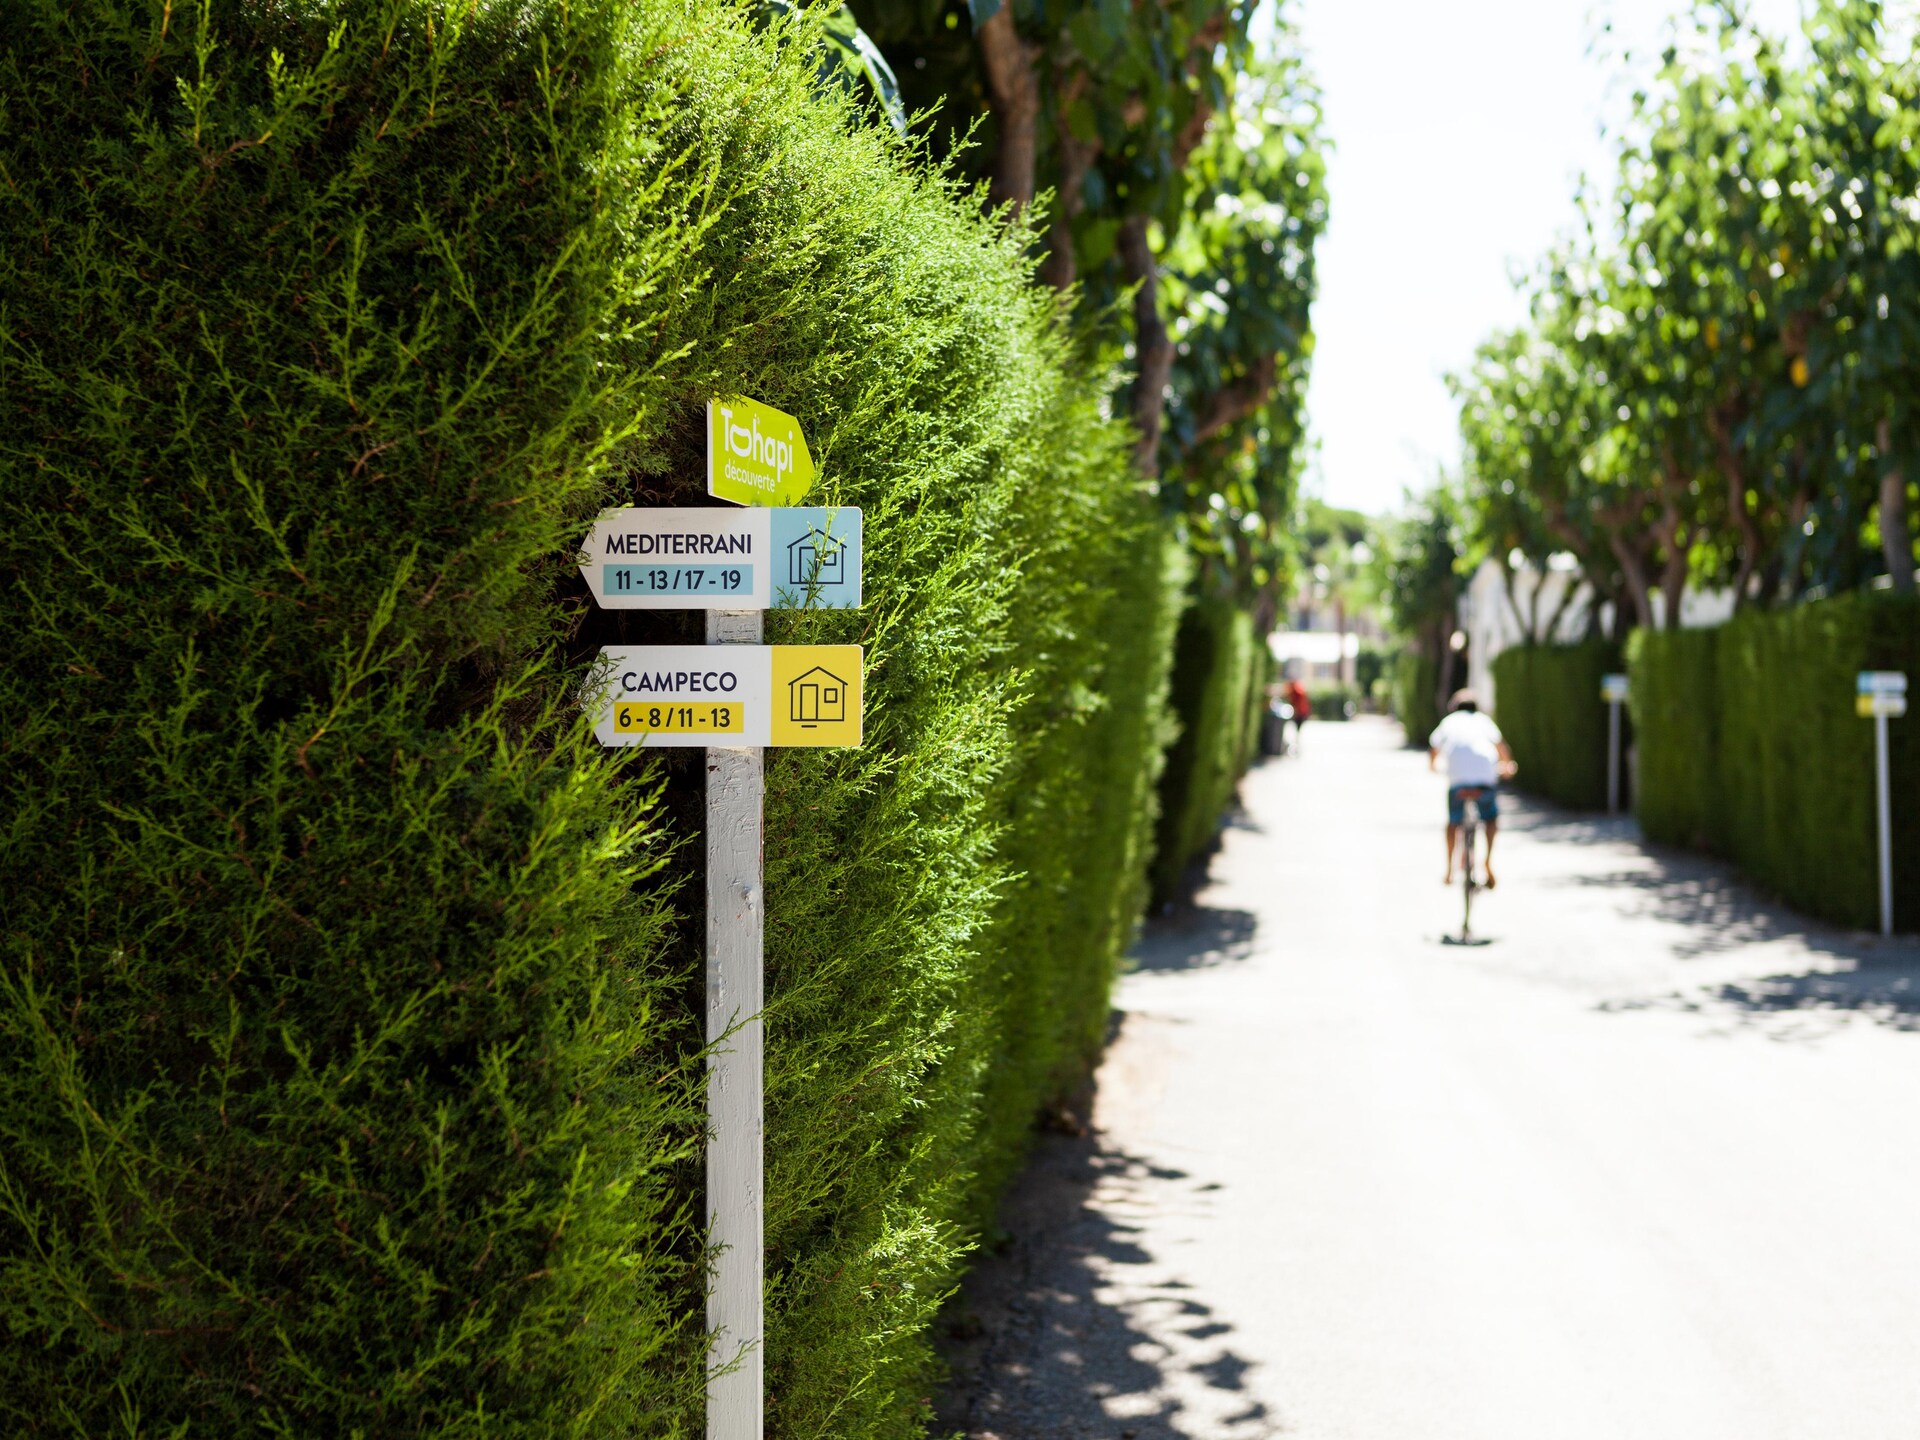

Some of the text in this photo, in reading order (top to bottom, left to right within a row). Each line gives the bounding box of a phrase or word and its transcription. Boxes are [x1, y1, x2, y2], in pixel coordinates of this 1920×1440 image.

[720, 406, 793, 483] Tohapi
[724, 458, 776, 493] découverte
[605, 533, 752, 555] MEDITERRANI
[622, 671, 738, 693] CAMPECO
